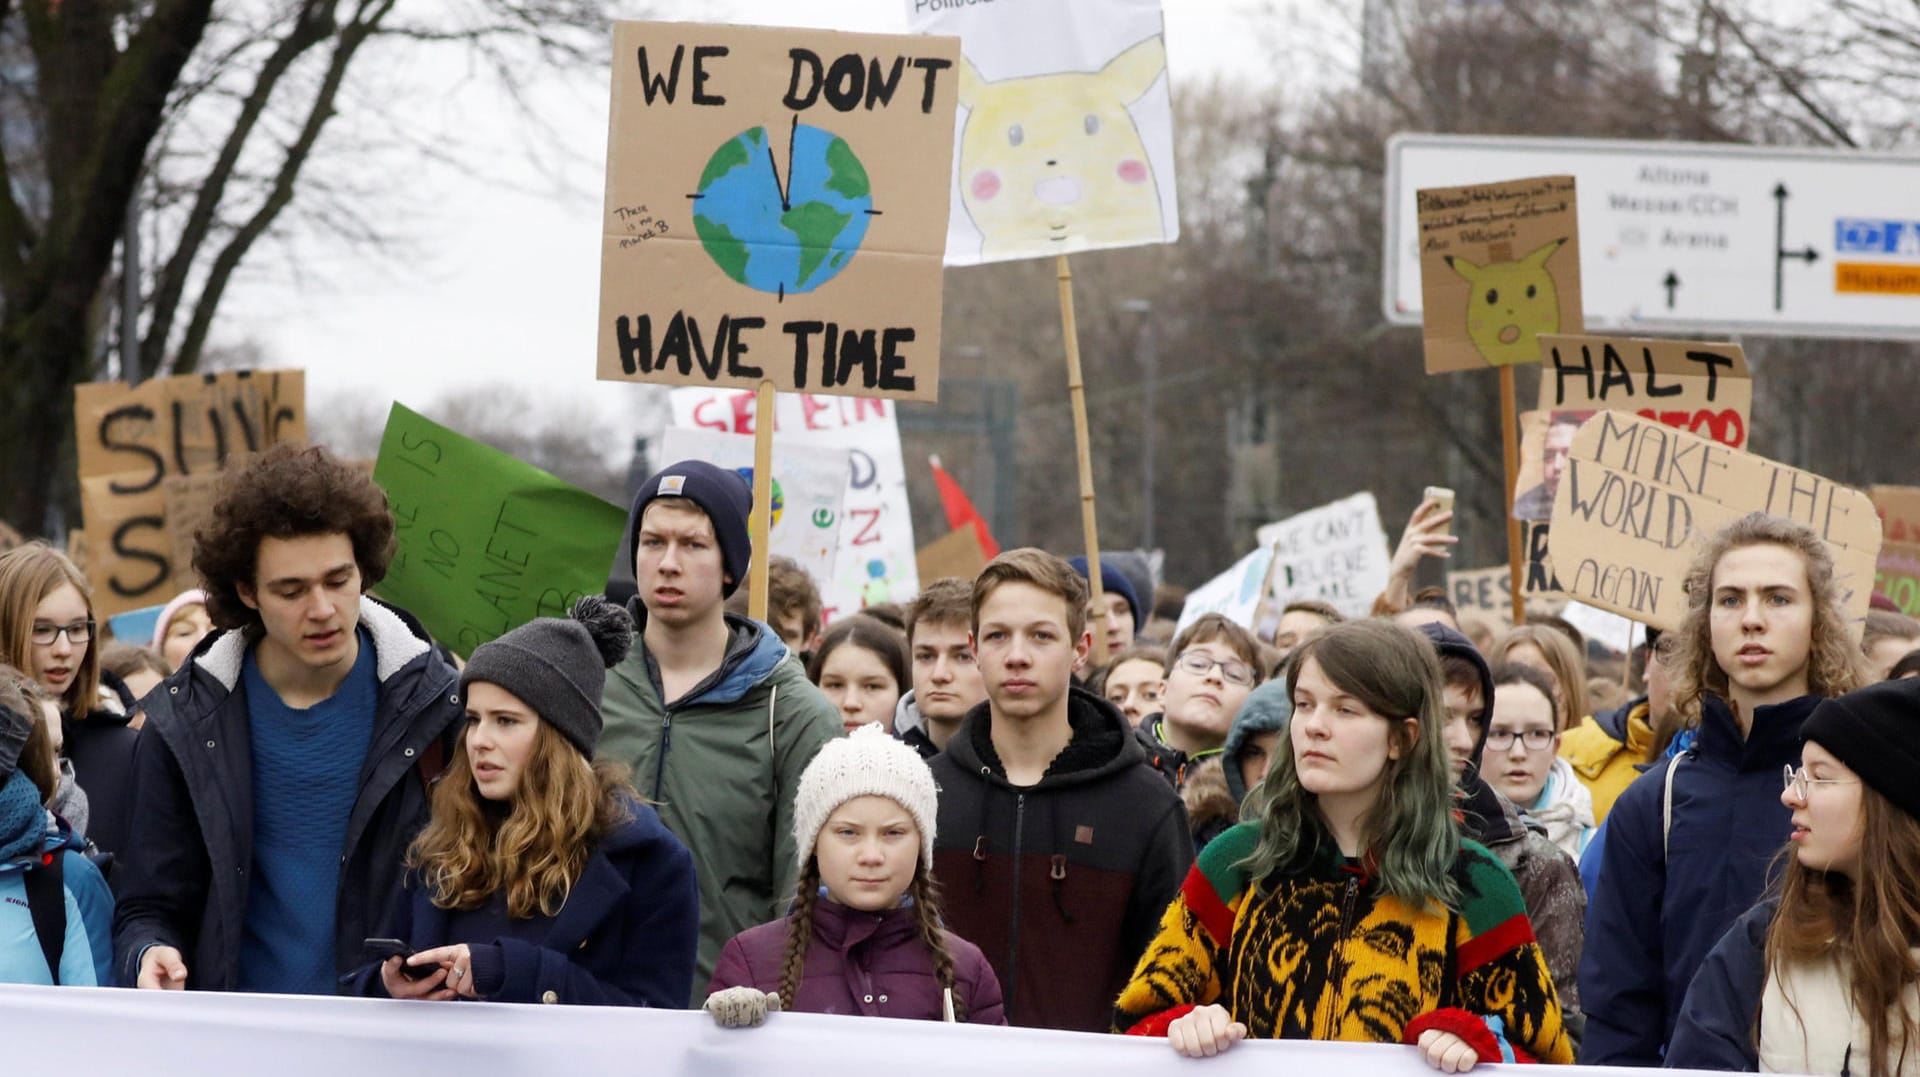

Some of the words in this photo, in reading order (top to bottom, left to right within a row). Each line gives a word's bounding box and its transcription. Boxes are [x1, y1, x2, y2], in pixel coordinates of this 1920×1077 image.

[638, 44, 729, 106] WE
[782, 48, 953, 114] DON'T
[654, 219, 669, 233] B
[616, 310, 766, 380] HAVE
[782, 320, 916, 391] TIME
[1551, 343, 1733, 406] HALT
[395, 431, 442, 478] IS
[1594, 411, 1730, 504] MAKE
[1760, 460, 1858, 551] THE
[1569, 458, 1694, 551] WORLD
[423, 528, 461, 581] NO
[1571, 558, 1664, 615] AGAIN
